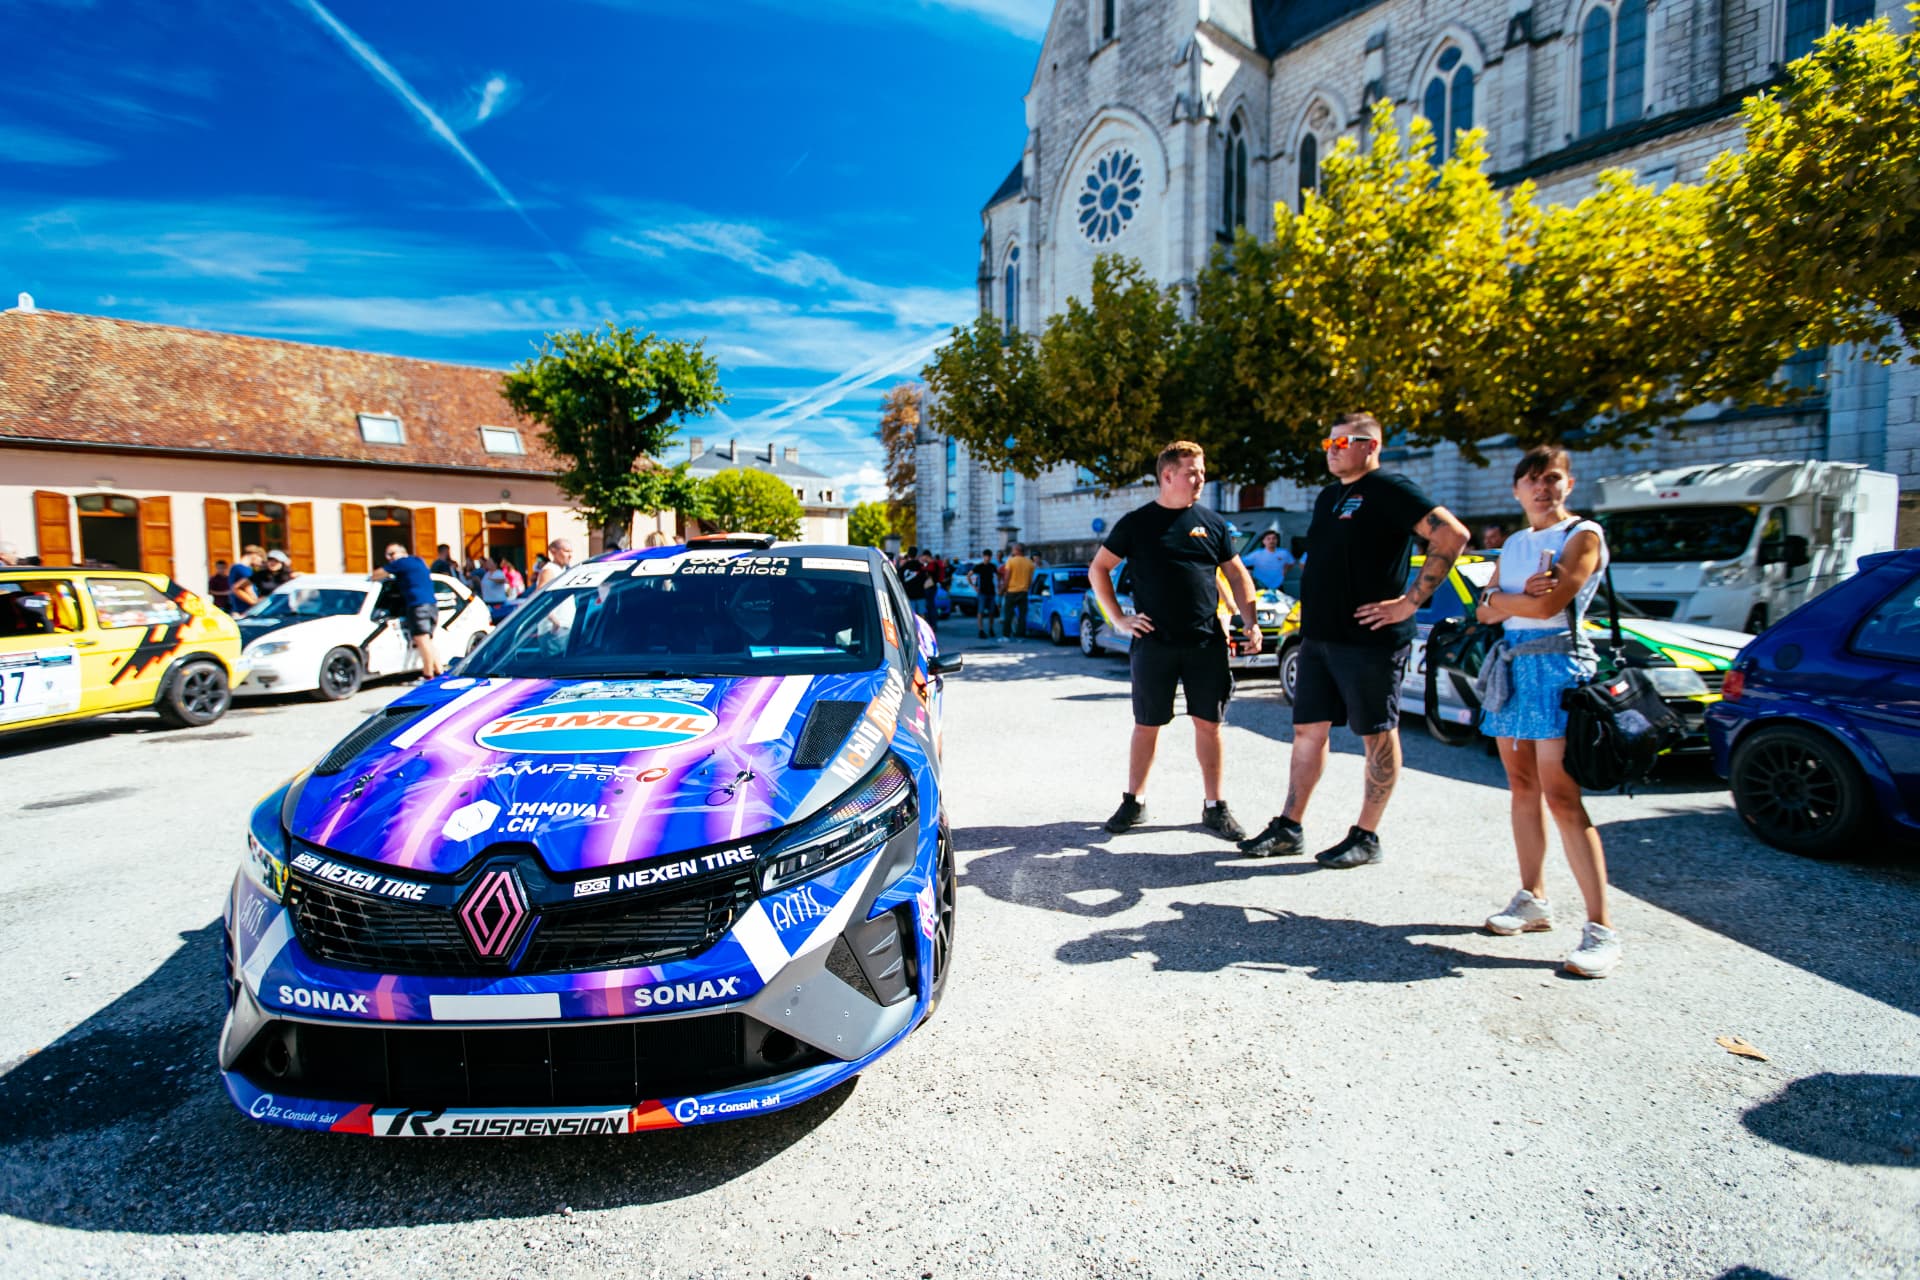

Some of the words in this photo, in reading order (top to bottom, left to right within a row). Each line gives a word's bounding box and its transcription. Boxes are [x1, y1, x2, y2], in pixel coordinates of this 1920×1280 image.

[681, 566, 727, 575] data
[730, 565, 788, 576] pilots
[489, 714, 706, 734] TAMOIL
[507, 802, 610, 818] IMMOVAL
[498, 817, 540, 833] .CH
[617, 858, 699, 890] NEXEN
[700, 845, 756, 870] TIRE
[314, 861, 383, 891] NEXEN
[379, 879, 432, 901] TIRE
[278, 984, 369, 1013] SONAX
[634, 976, 739, 1007] SONAX
[267, 1106, 281, 1118] BZ
[282, 1109, 317, 1122] Consult
[700, 1104, 715, 1116] BZ
[718, 1098, 759, 1113] Consult
